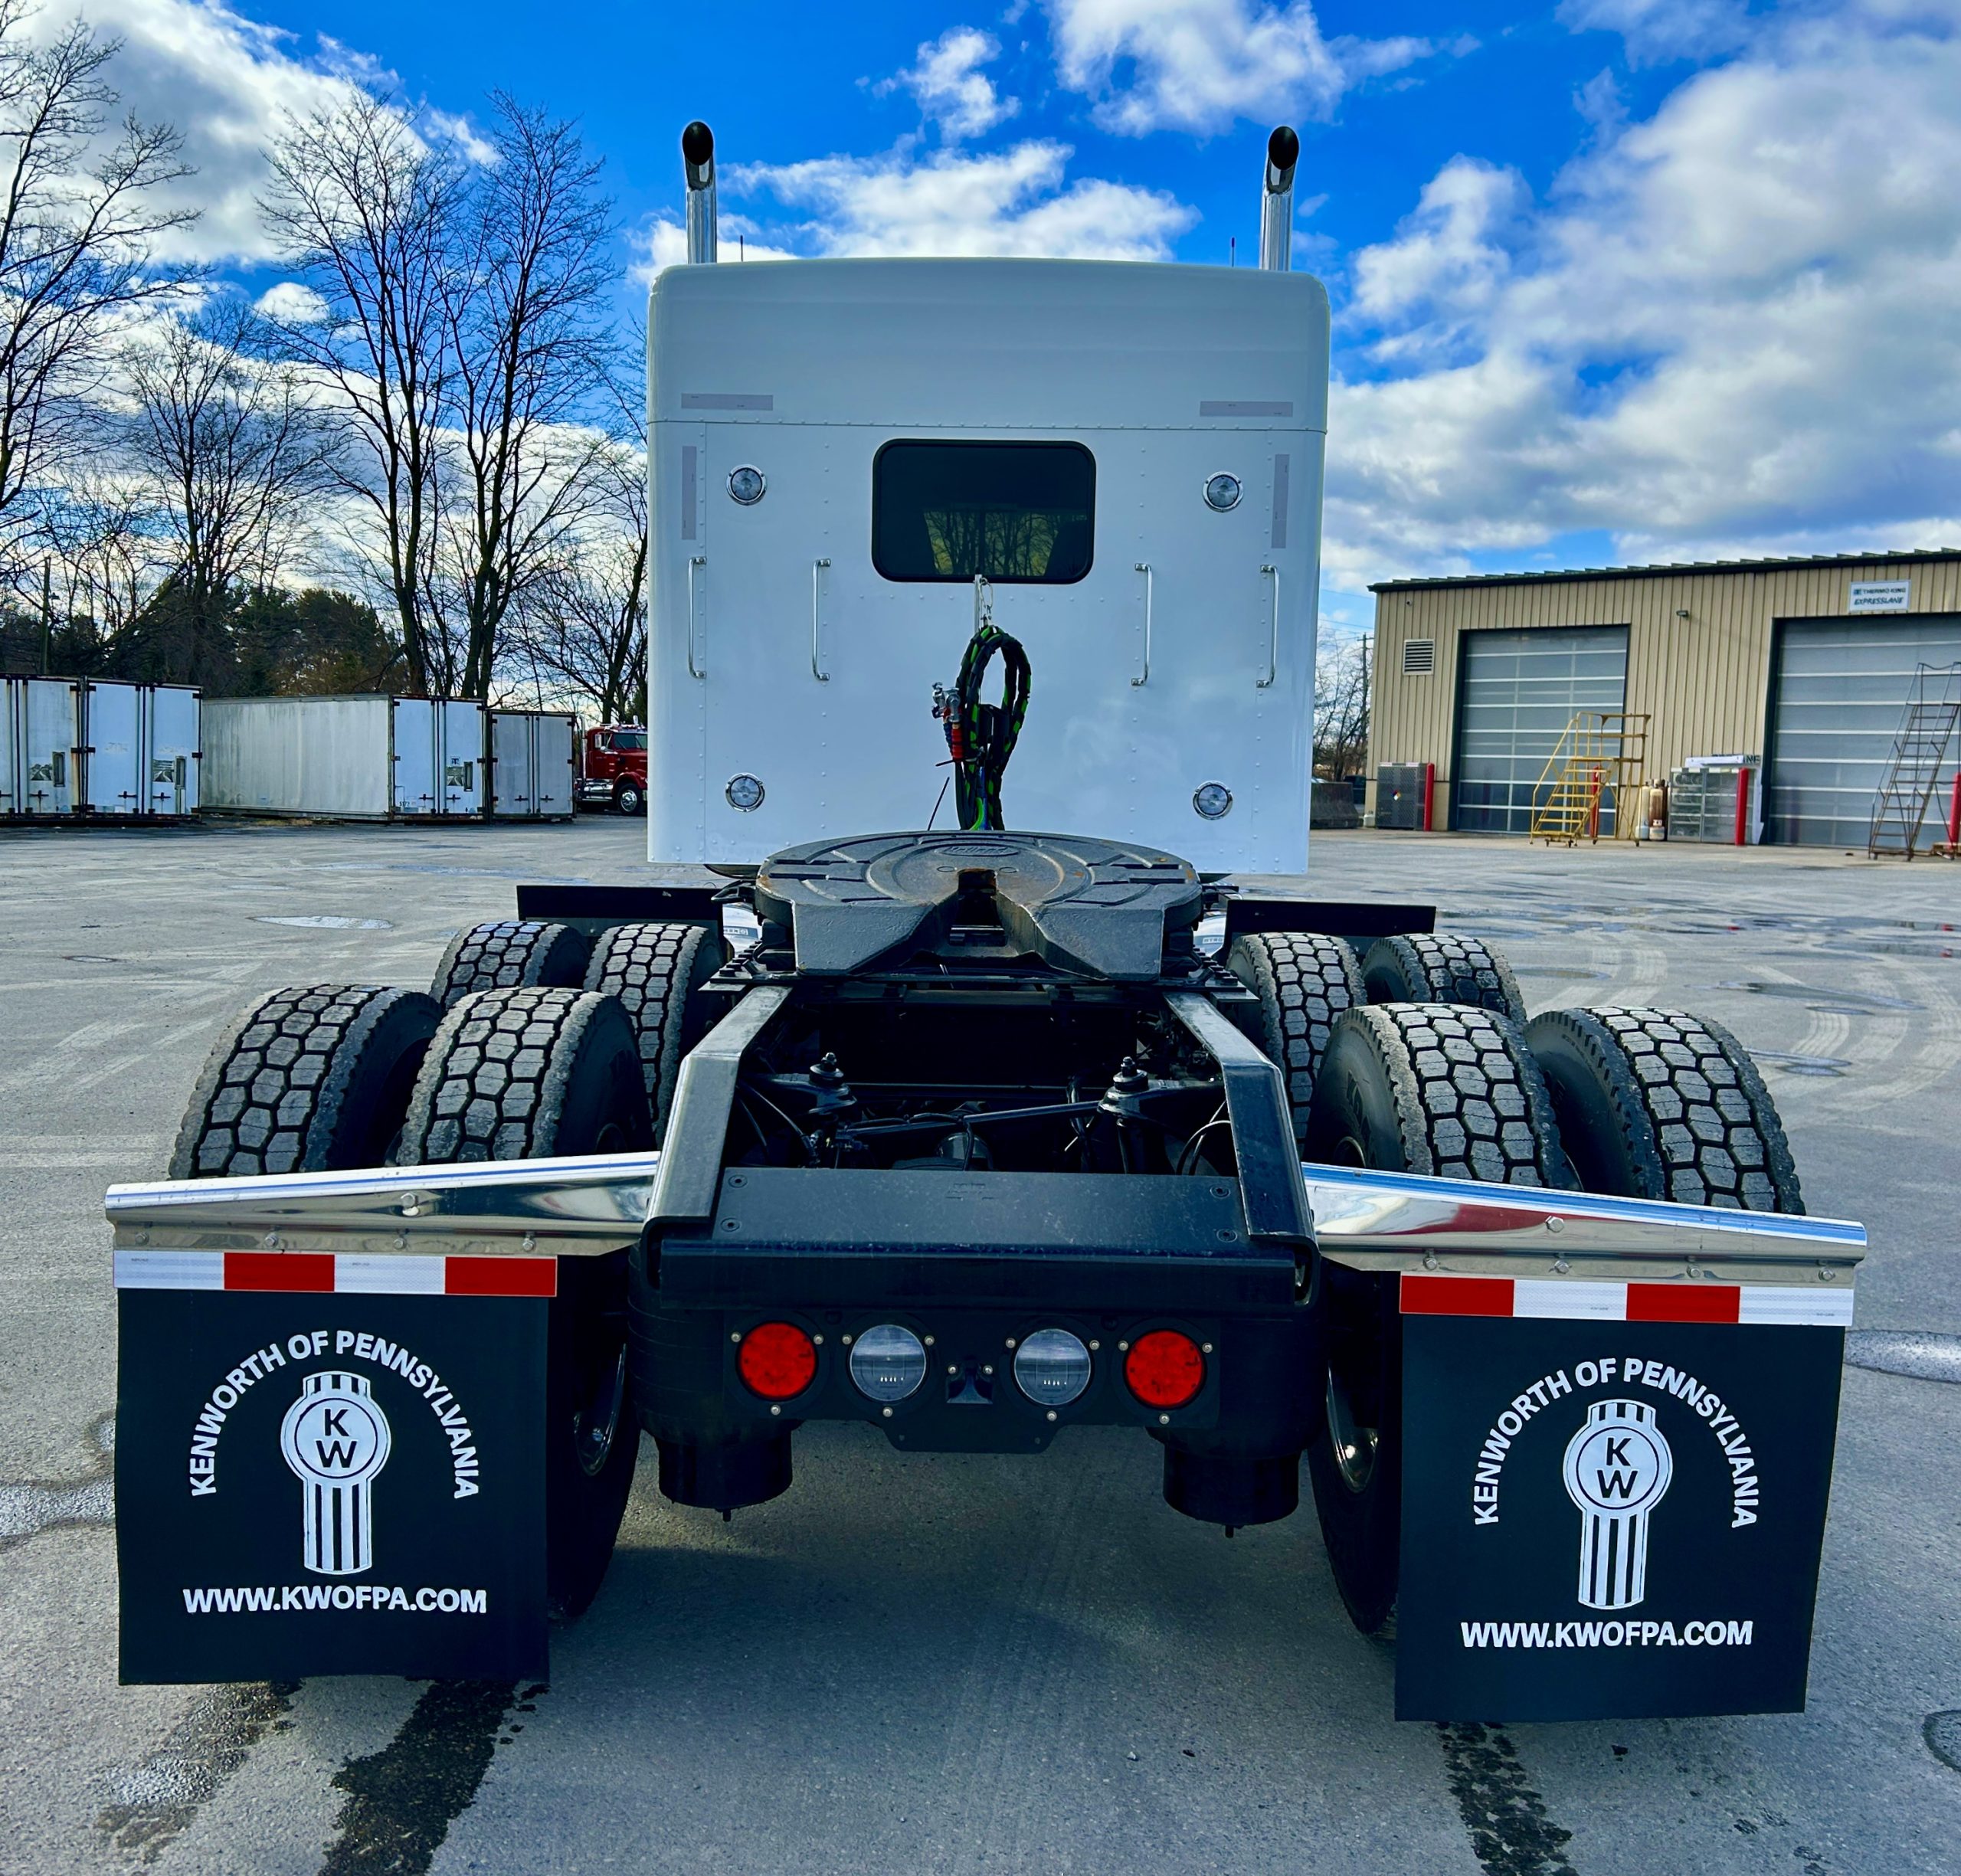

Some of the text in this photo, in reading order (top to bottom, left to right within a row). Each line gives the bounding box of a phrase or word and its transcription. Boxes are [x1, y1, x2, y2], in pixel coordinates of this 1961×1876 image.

[1855, 597, 1904, 605] EXPRESSLANE
[189, 1330, 480, 1499] KENWORTH OF PENNSYLVANIA
[1473, 1357, 1760, 1528] KENWORTH OF PENNSYLVANIA
[182, 1585, 487, 1614] WWW.KWOFPA.COM
[1460, 1620, 1753, 1648] WWW.KWOFPA.COM
